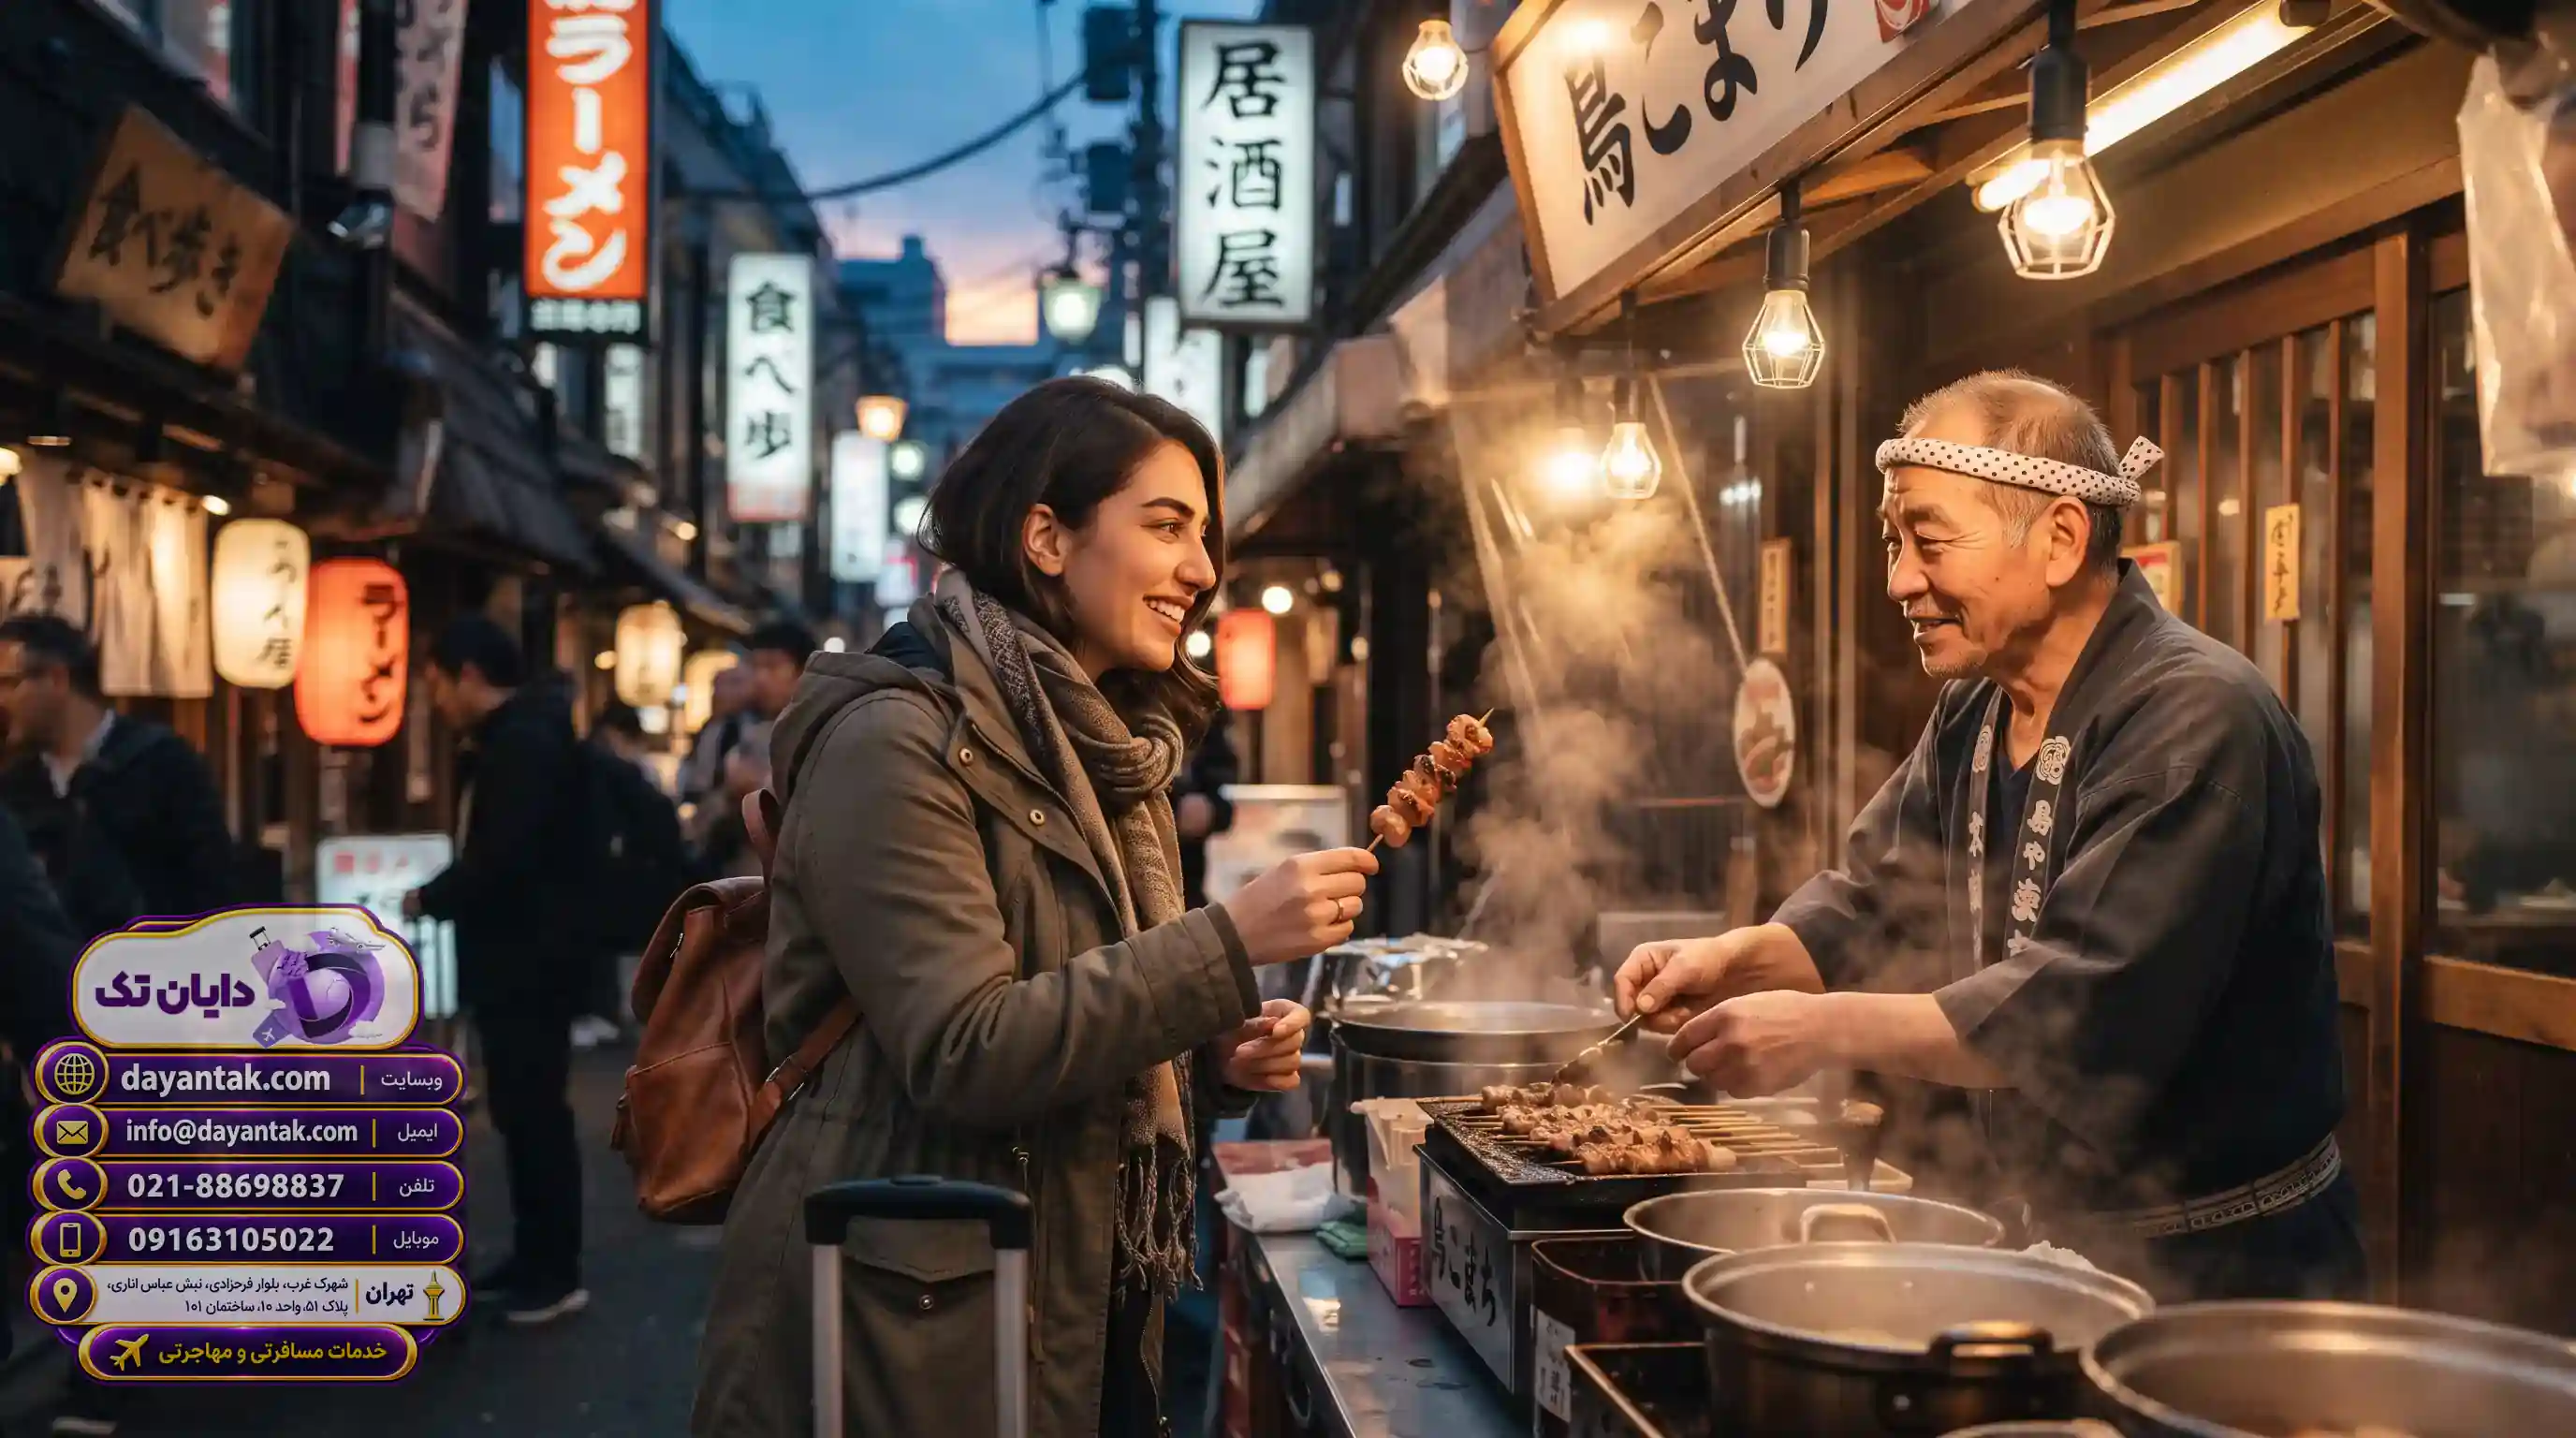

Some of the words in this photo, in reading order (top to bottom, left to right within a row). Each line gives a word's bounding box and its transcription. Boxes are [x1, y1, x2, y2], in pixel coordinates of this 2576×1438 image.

[540, 0, 633, 291] ラーメン
[1200, 40, 1287, 310] 居酒屋
